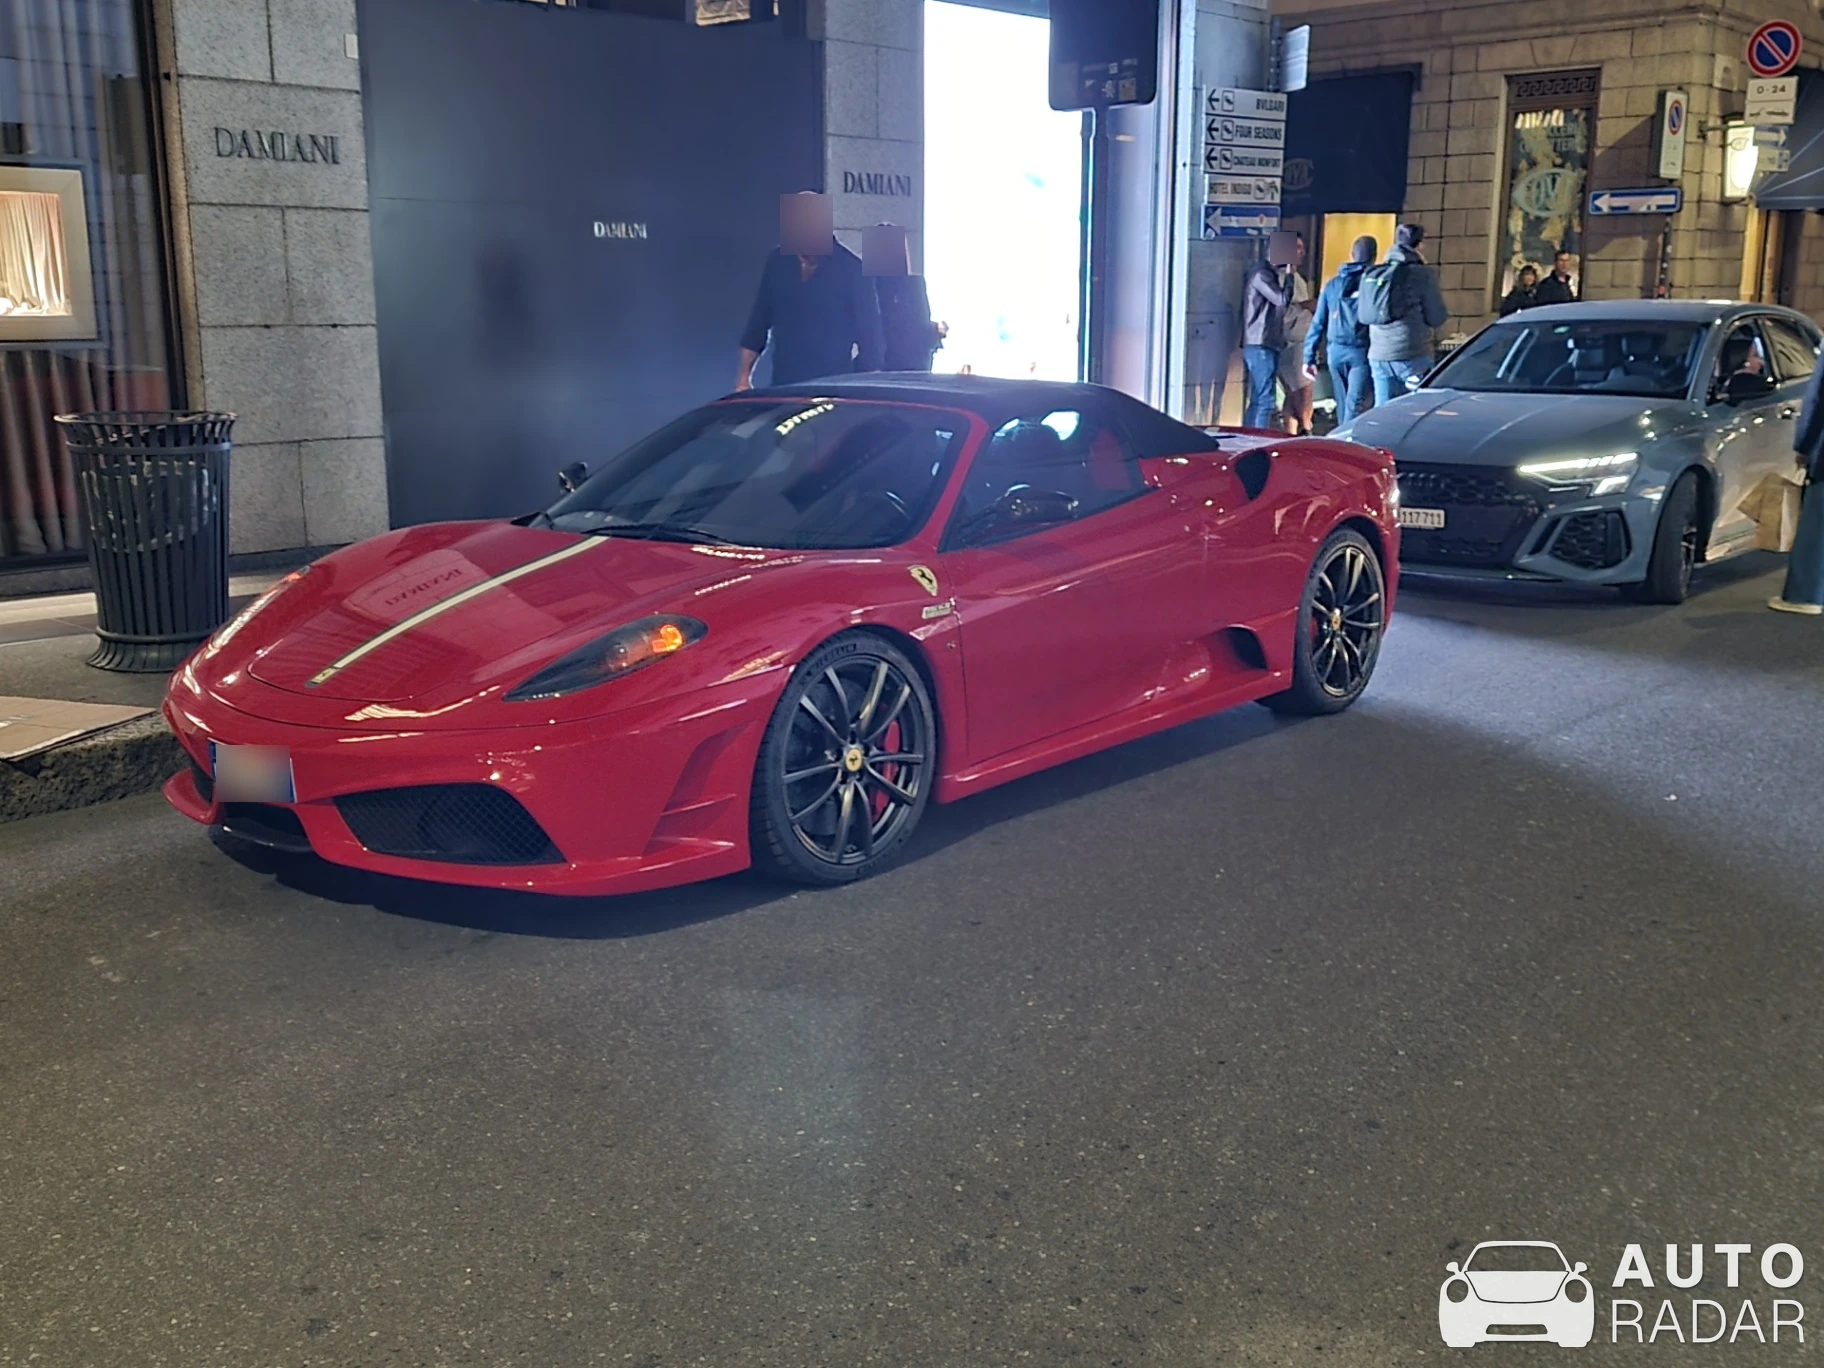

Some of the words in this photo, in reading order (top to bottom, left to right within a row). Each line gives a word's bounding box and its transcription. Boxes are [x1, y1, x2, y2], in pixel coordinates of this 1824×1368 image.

[1235, 125, 1252, 138] FOUR
[1254, 126, 1282, 140] SEASONS
[214, 126, 342, 165] DAMIANI
[843, 170, 912, 197] DAMIANI
[593, 220, 648, 239] DAMIANI
[1402, 511, 1441, 525] 117711
